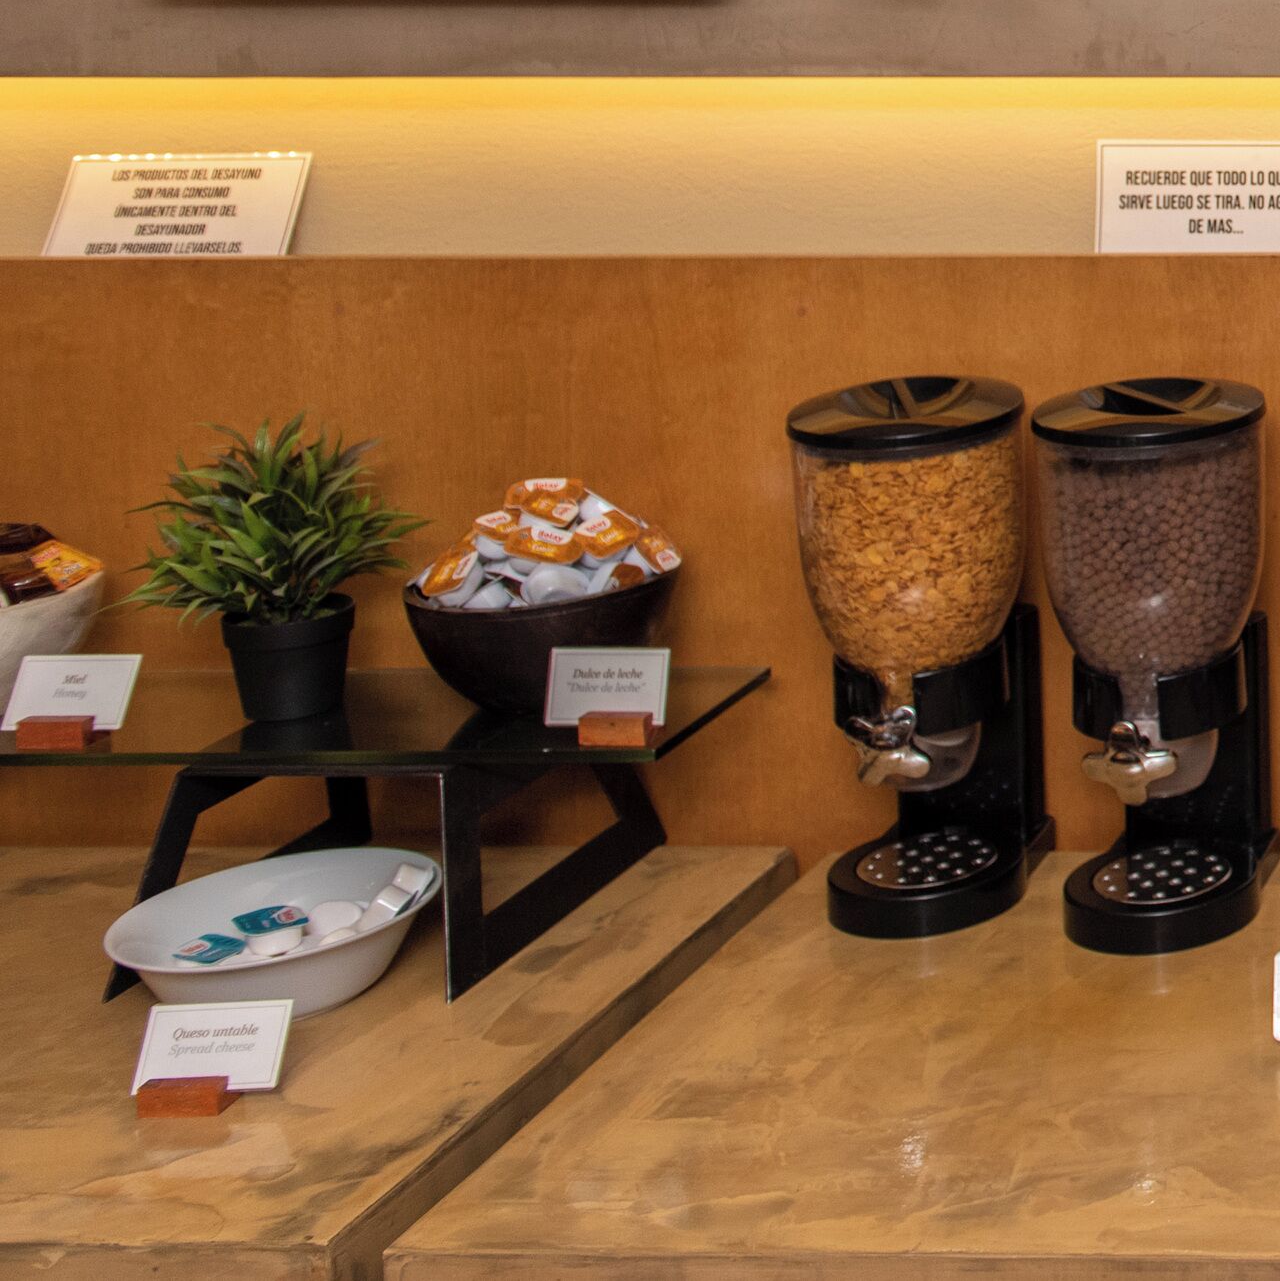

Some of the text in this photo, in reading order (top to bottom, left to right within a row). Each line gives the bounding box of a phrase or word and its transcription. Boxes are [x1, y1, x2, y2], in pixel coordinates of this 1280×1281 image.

[112, 168, 261, 181] LOS PRODUCTOS DEL DESAYUNO
[1126, 170, 1186, 186] RECUERDE
[1190, 170, 1213, 186] QUE
[1216, 170, 1247, 186] TODO
[1250, 170, 1265, 186] LO
[133, 186, 230, 199] SON PARA CONSUMO
[1119, 194, 1153, 210] SIRVE
[1156, 194, 1193, 210] LUEGO
[1197, 194, 1212, 210] SE
[1215, 194, 1245, 210] TIRA.
[1248, 194, 1265, 210] NO
[178, 205, 217, 217] DENTRO
[219, 205, 237, 217] DEL
[134, 224, 206, 236] DESAYUNADOR
[1188, 219, 1244, 234] DE MAS...
[85, 243, 117, 255] QUEDA
[119, 243, 172, 254] PROHIBIDO
[573, 669, 642, 679] Dulce de leche
[600, 682, 612, 693] de
[173, 1023, 259, 1041] Queso untable
[168, 1040, 256, 1059] Spread cheese
